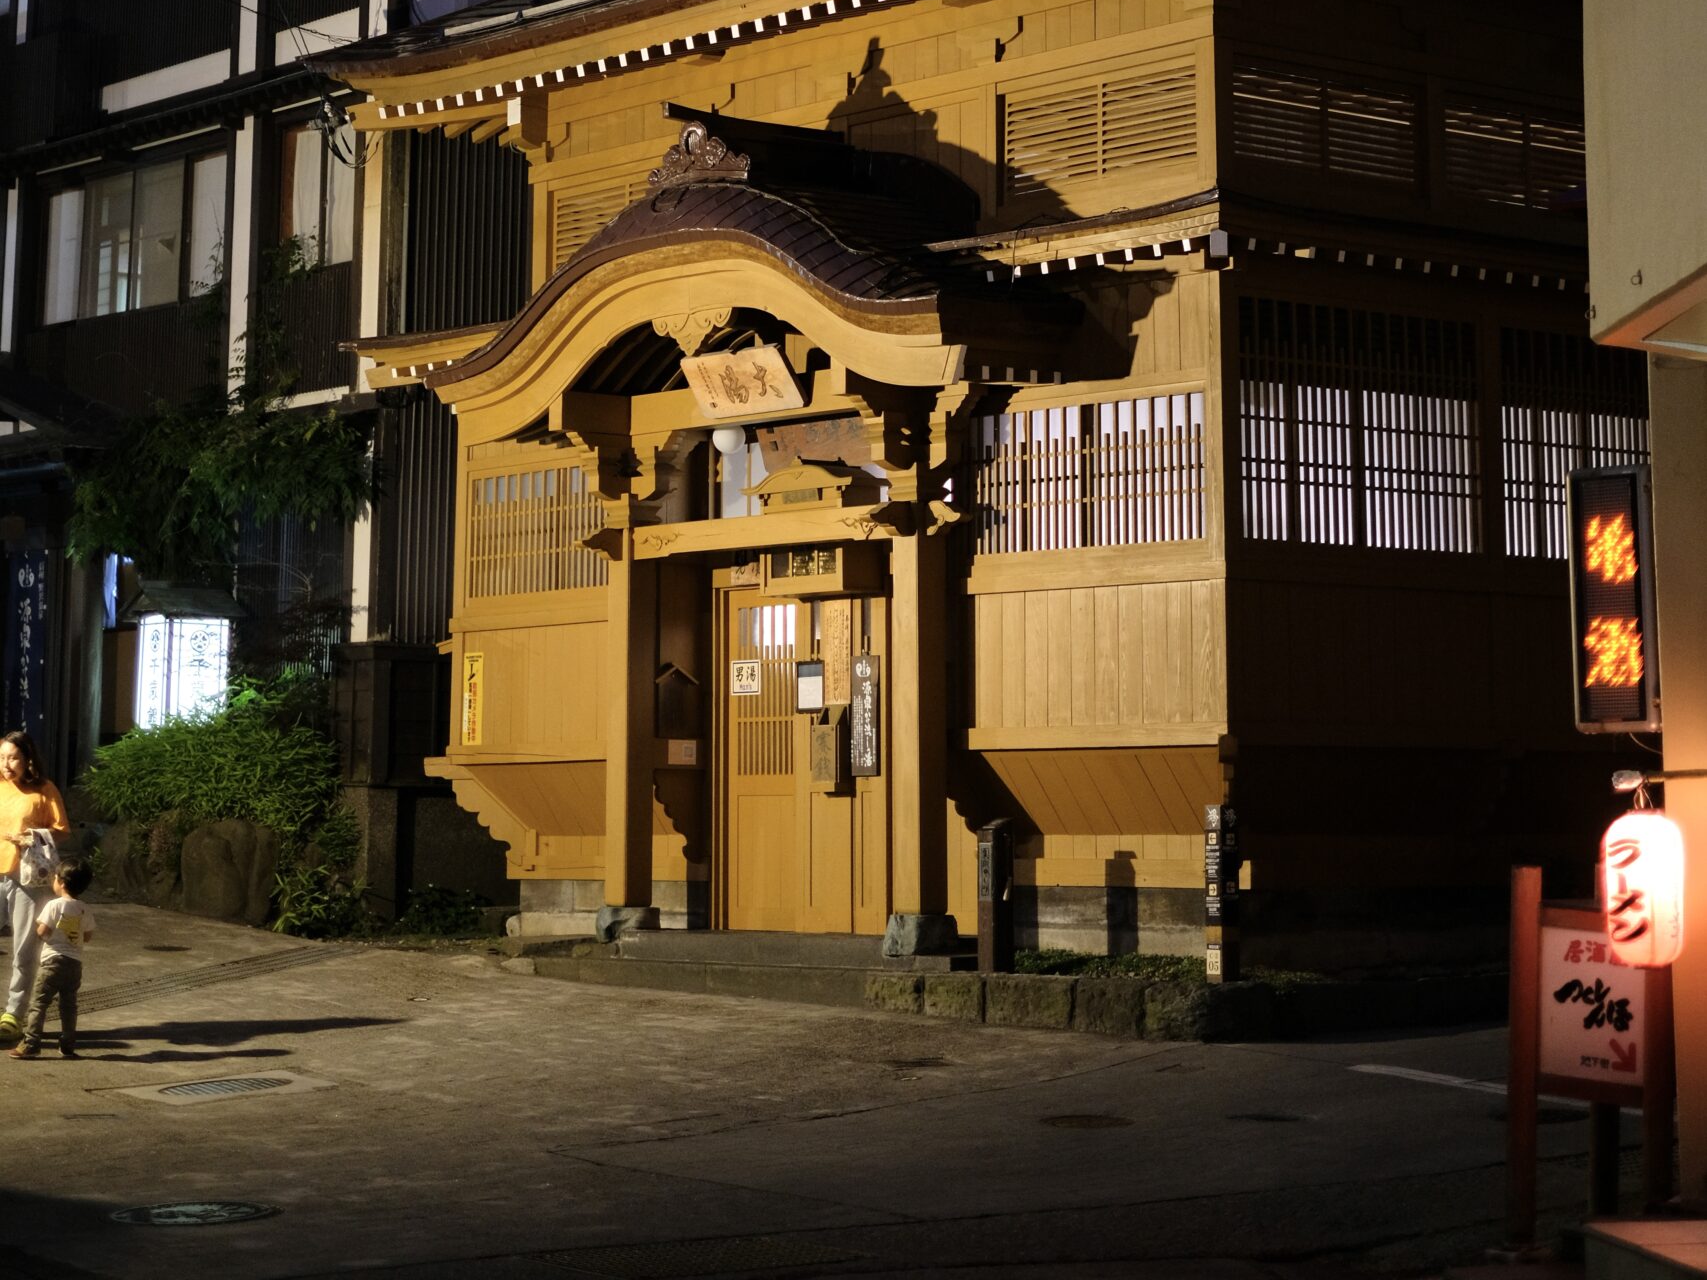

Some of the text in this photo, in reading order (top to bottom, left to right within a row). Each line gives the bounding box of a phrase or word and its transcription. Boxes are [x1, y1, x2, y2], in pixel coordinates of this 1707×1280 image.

[736, 665, 757, 682] 男湯
[1608, 838, 1648, 942] ラーメン
[1564, 939, 1628, 967] 居酒
